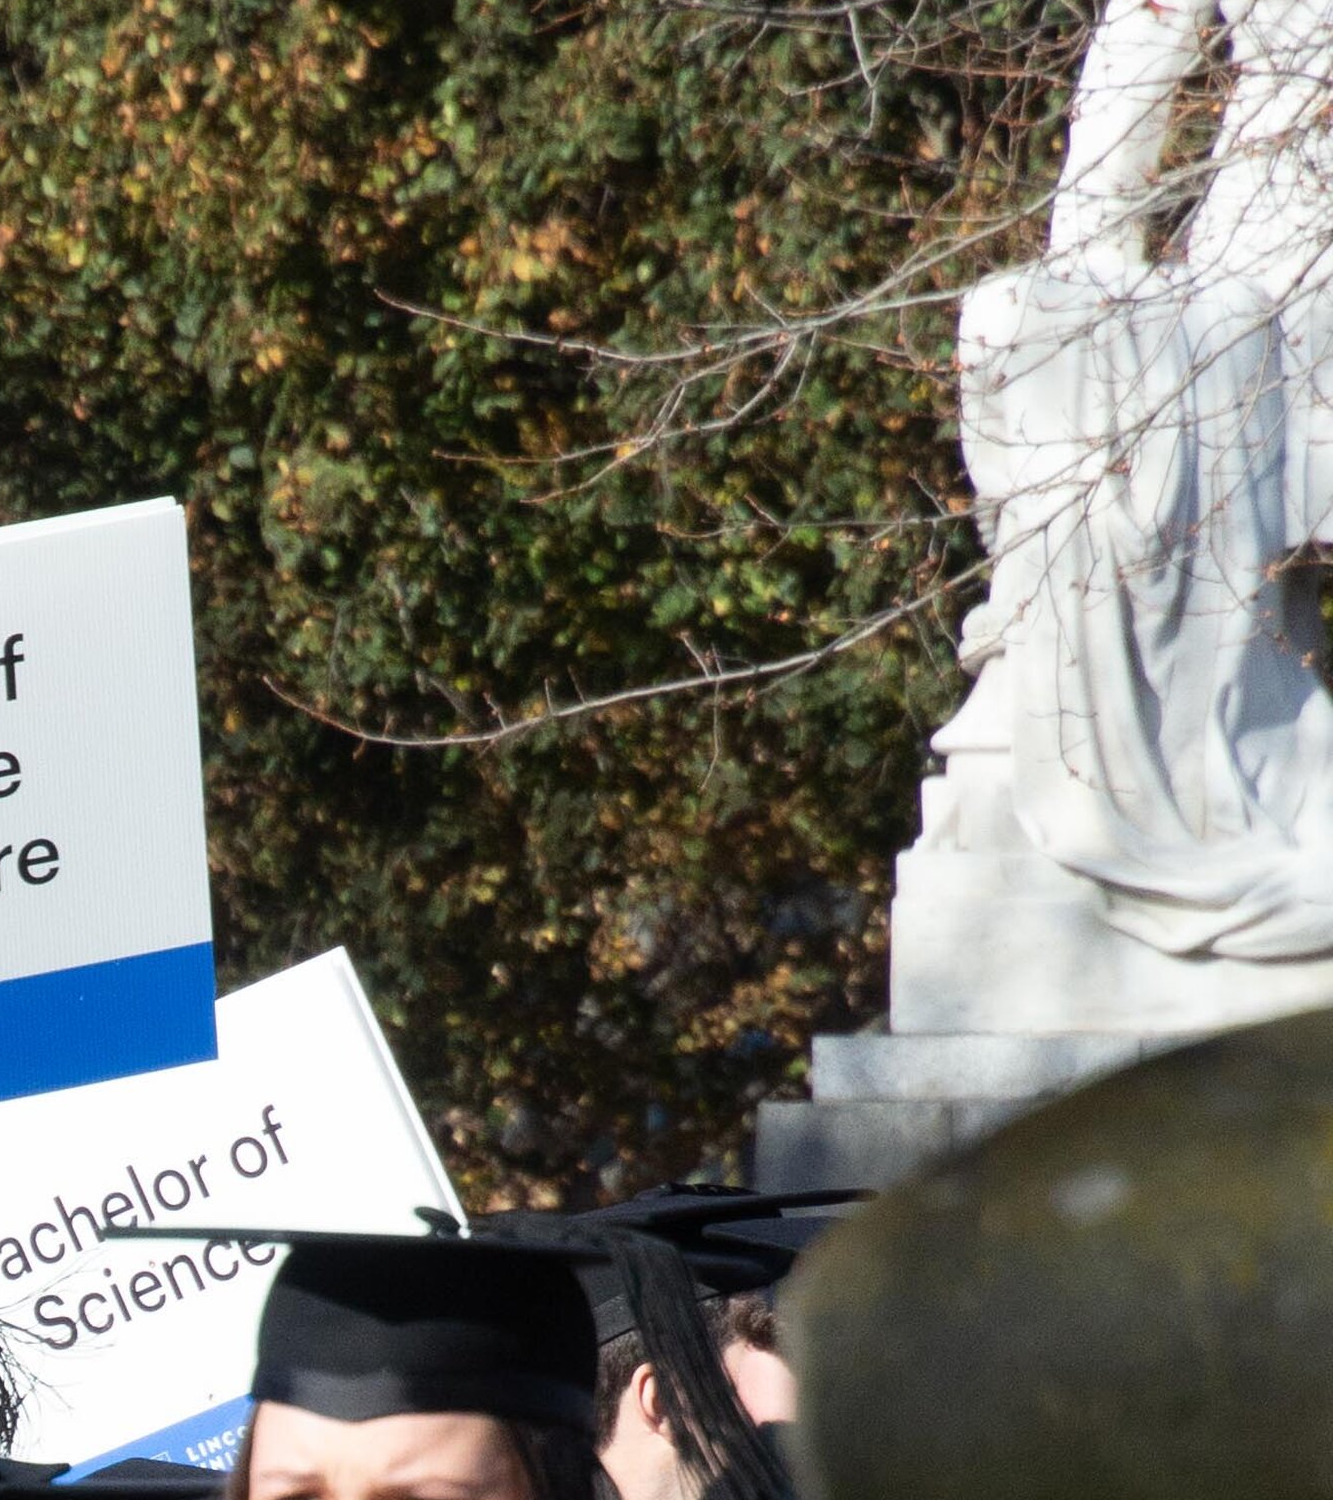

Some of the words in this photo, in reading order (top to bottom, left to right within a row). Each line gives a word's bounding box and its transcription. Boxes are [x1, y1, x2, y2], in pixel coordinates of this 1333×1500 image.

[230, 1104, 289, 1178] of
[33, 1238, 276, 1350] Science
[185, 1425, 249, 1462] LINCO
